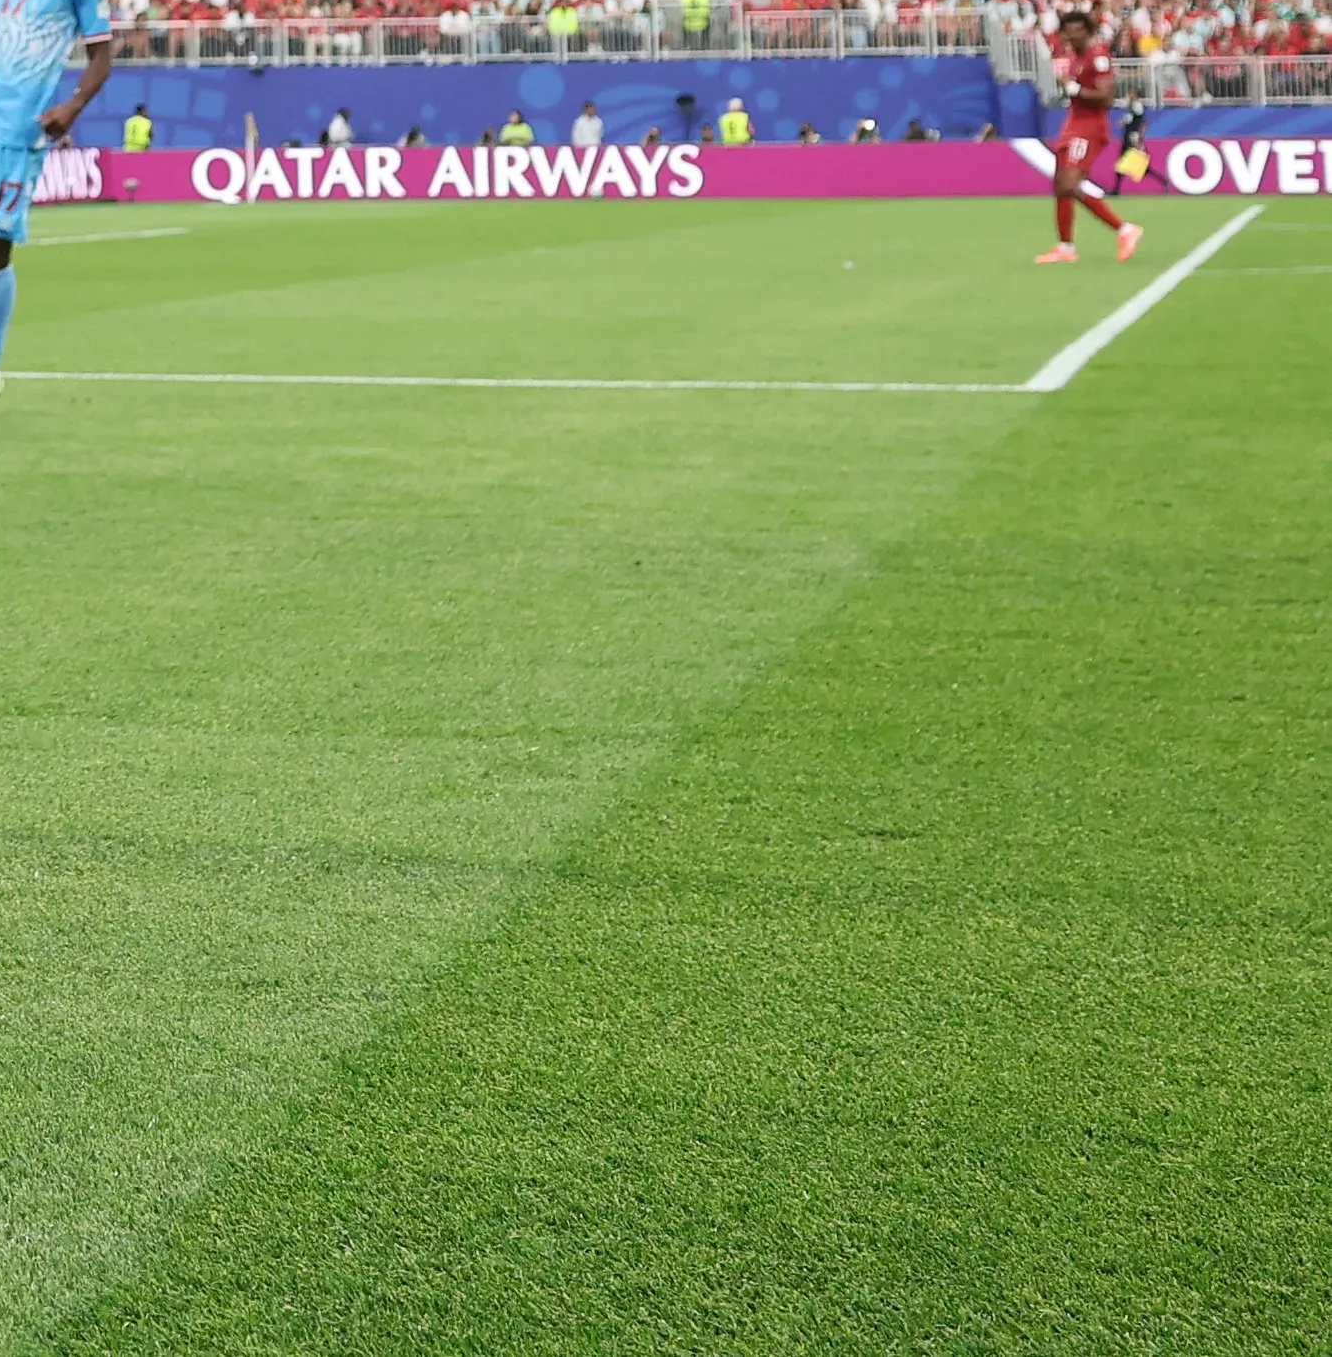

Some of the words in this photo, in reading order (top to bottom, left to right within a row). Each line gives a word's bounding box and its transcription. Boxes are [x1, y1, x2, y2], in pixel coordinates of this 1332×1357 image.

[191, 147, 406, 204] QATAR
[428, 144, 704, 198] AIRWAYS
[1166, 139, 1332, 195] OVE
